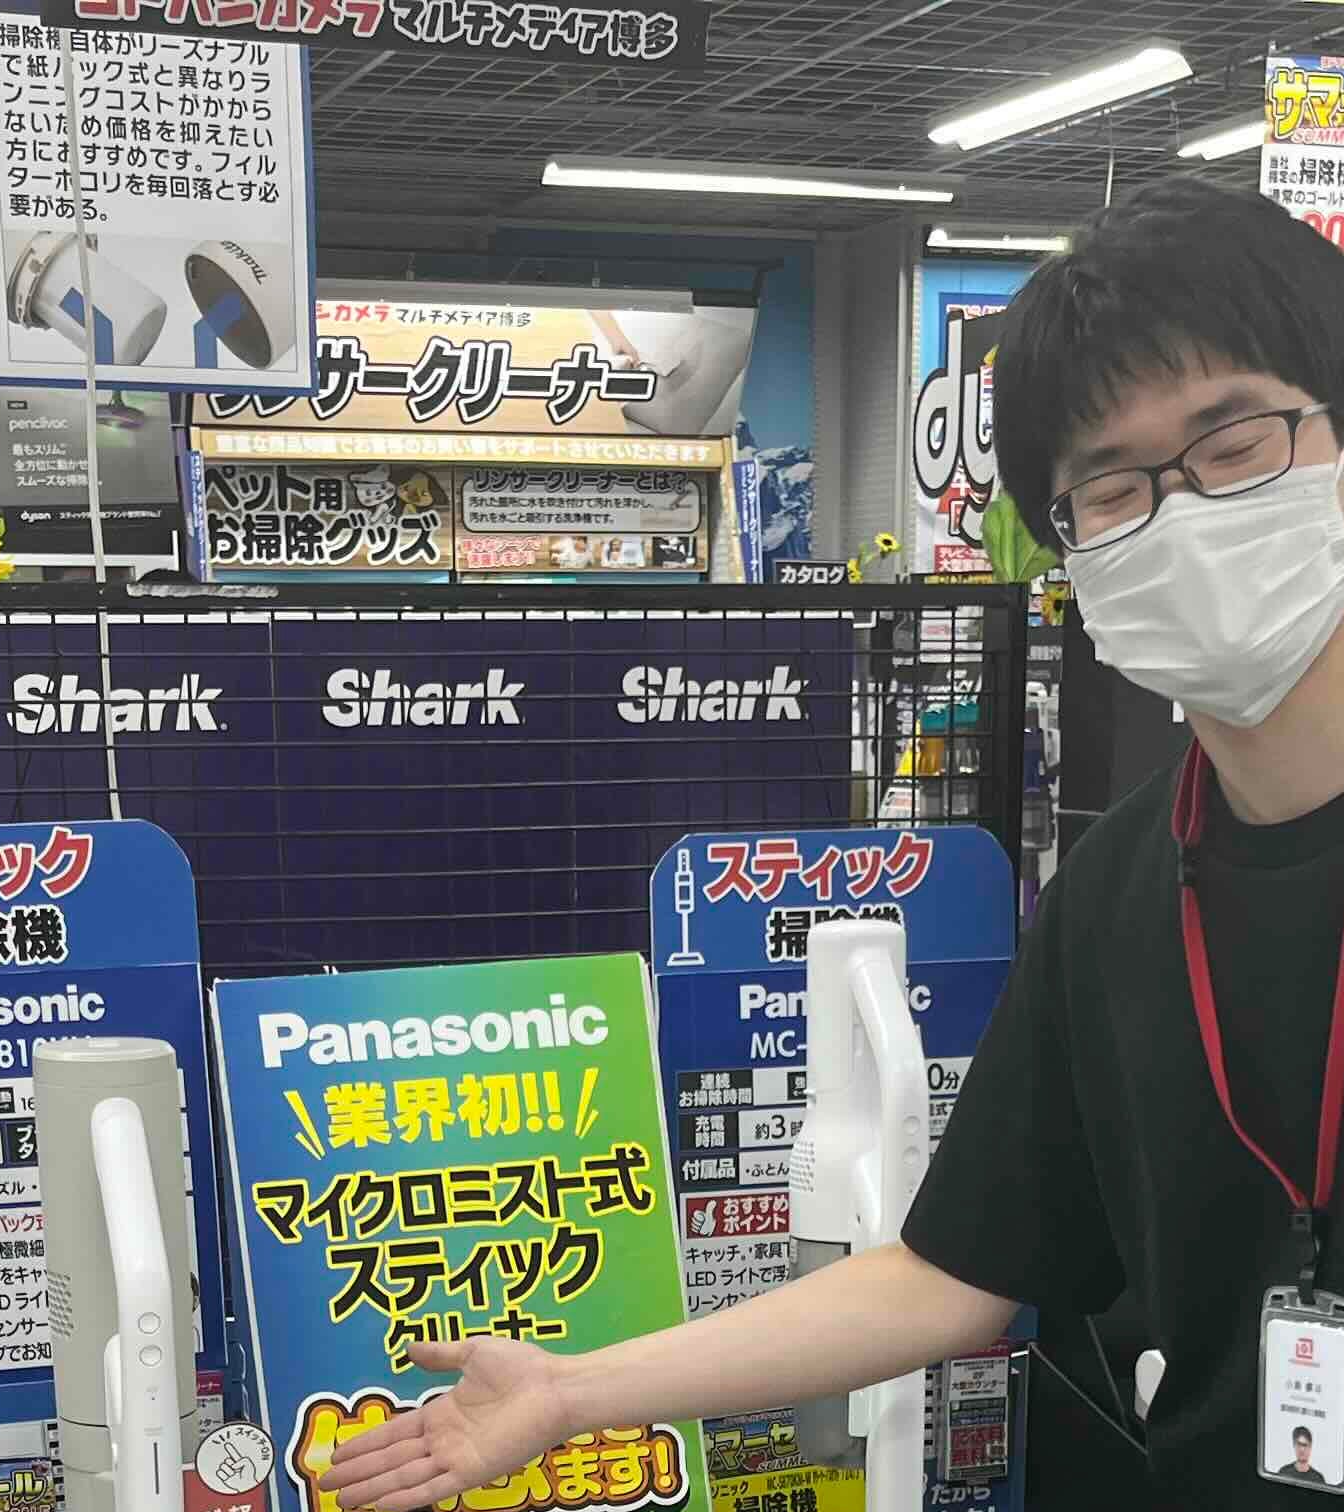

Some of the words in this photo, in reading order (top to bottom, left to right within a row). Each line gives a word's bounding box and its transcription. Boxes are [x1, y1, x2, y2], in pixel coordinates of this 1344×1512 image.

[391, 0, 680, 59] マルチメディア博多
[395, 306, 531, 328] マルチメディア博多
[206, 466, 344, 512] ペット用
[206, 511, 439, 566] お掃除グッズ
[703, 832, 935, 901] スティック
[258, 994, 609, 1069] Panasonic
[678, 1088, 752, 1107] お掃除時間
[699, 1072, 731, 1089] 連続
[324, 1069, 564, 1149] 業界初!!
[252, 1142, 655, 1245] マイクロミスト式
[681, 1159, 736, 1182] 付属品
[722, 1198, 788, 1217] おすすめ
[723, 1214, 787, 1234] ポイント
[328, 1224, 604, 1322] スティック
